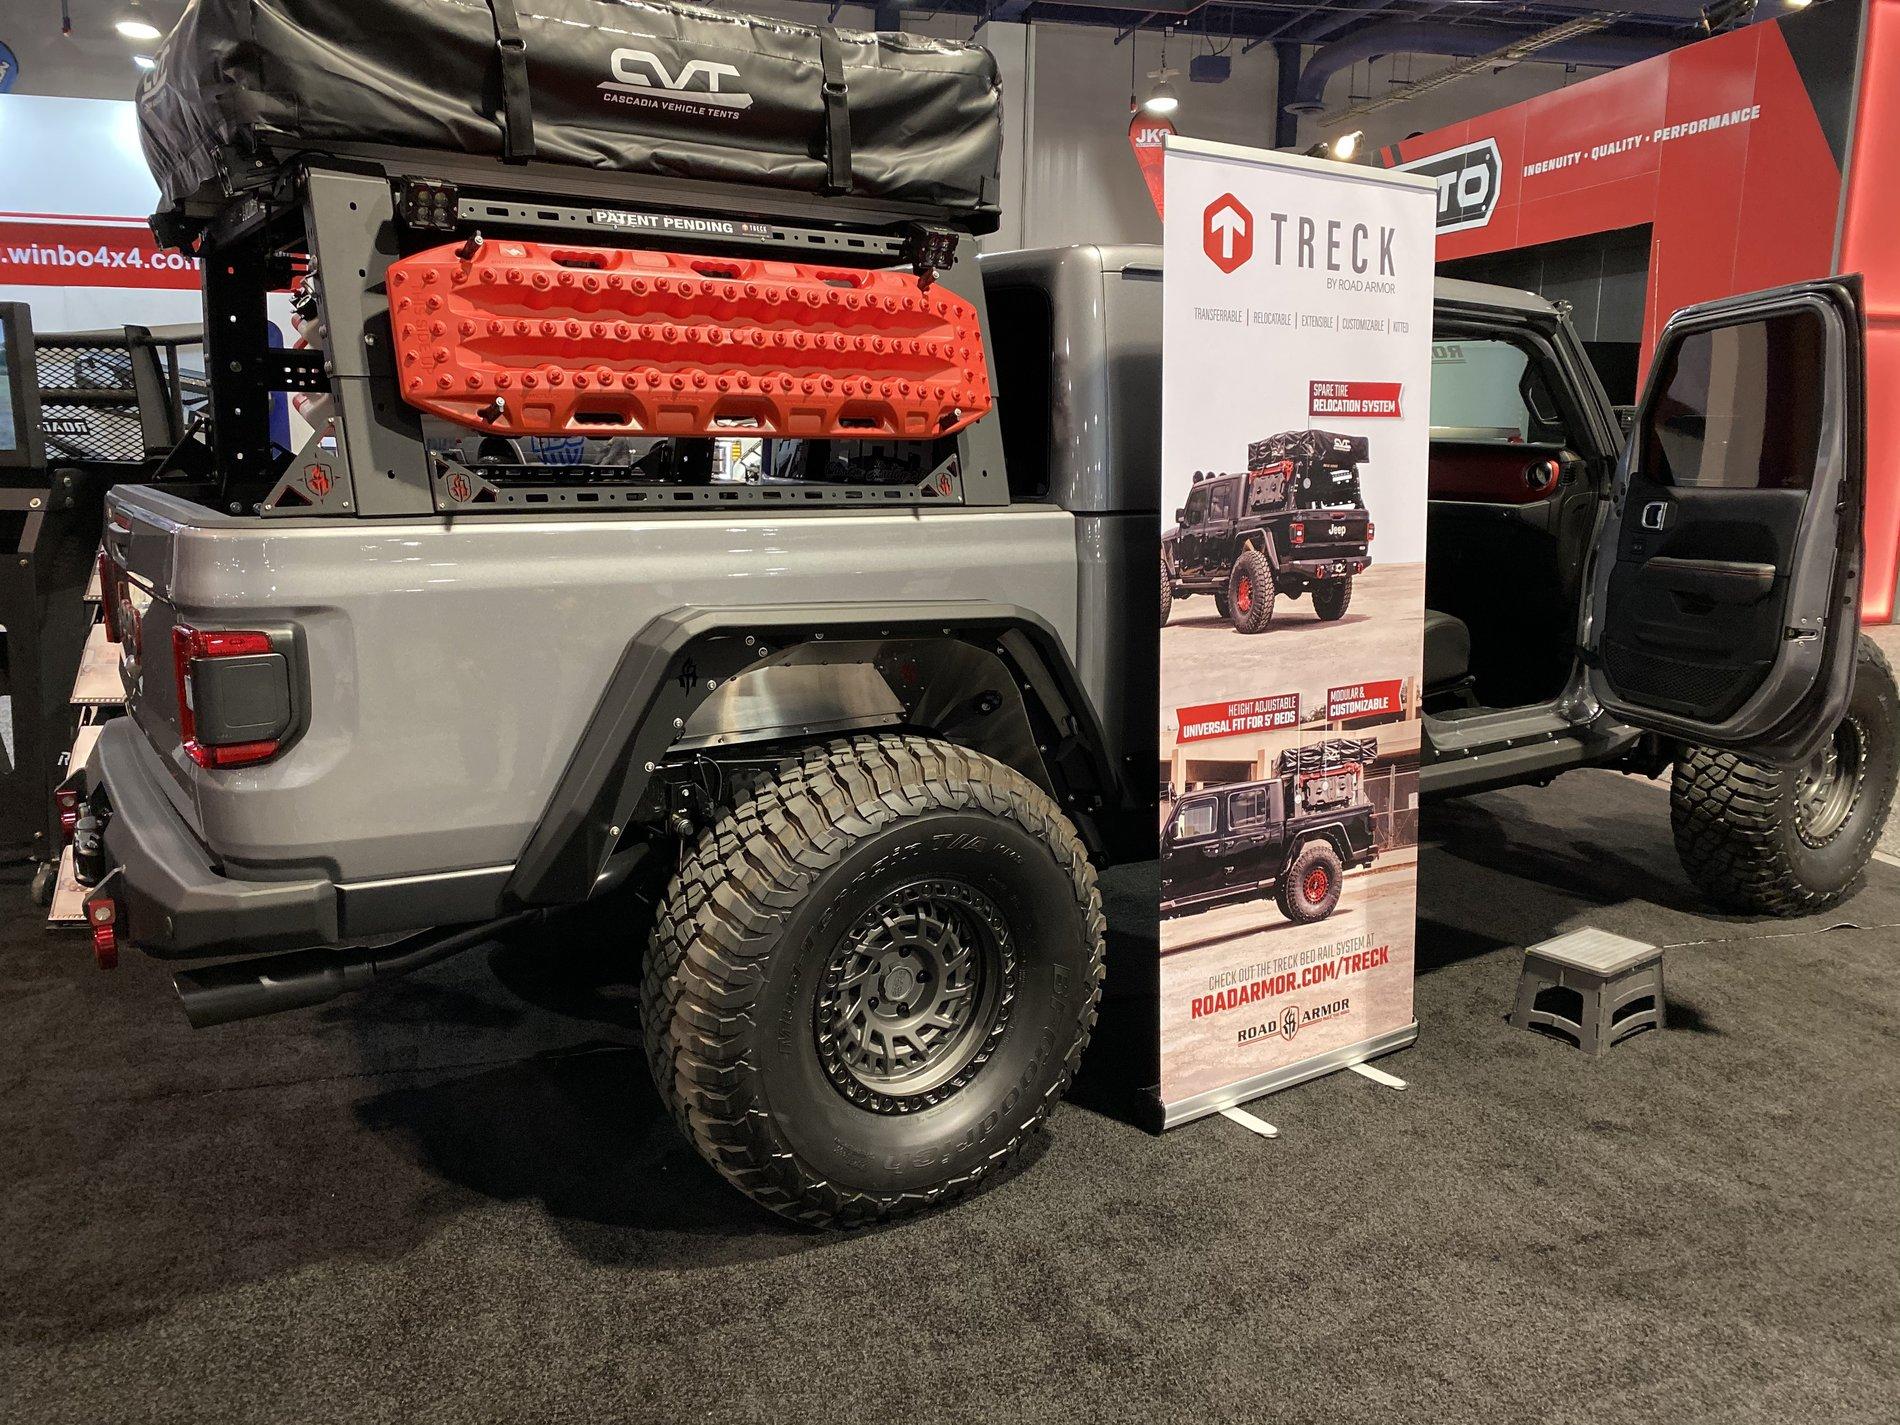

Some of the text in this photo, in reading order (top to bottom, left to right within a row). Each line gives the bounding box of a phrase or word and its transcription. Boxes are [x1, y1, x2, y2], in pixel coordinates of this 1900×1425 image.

[610, 47, 741, 92] CVT
[603, 93, 740, 120] CASCADIA VEHICLE TENTS
[1523, 104, 1761, 178] INGENUITY QUALITY PERFORMANCE
[596, 211, 734, 234] PATENT PENDING
[1270, 212, 1396, 277] TRECK
[1326, 278, 1396, 294] BY ROAD ARMOR
[1194, 307, 1410, 334] TRANSFERRABLE RELOCATABLE EXTENSIBLE CUSTOMIZABLE KITTED
[1313, 383, 1349, 397] SPARE TIRE
[1313, 398, 1396, 413] RELOCATION SYSTEM
[1328, 524, 1347, 536] Jeep
[1228, 696, 1297, 717] HEIGHT ADJUSTABLE
[1330, 686, 1365, 702] MODULAR &
[1330, 696, 1389, 717] CUSTOMIZABLE
[1183, 719, 1231, 738] UNIVERSAL
[1232, 717, 1246, 731] FIT
[1247, 715, 1264, 729] FOR
[1274, 710, 1296, 725] BEDS
[1209, 932, 1375, 991] CHECK OUT THE TRECK BED RAIL SYSTEM AT
[1191, 945, 1390, 1020] ROADARMOR.COM/TRECK
[1237, 1020, 1277, 1043] ROAD
[1302, 998, 1350, 1023] ARMOR
